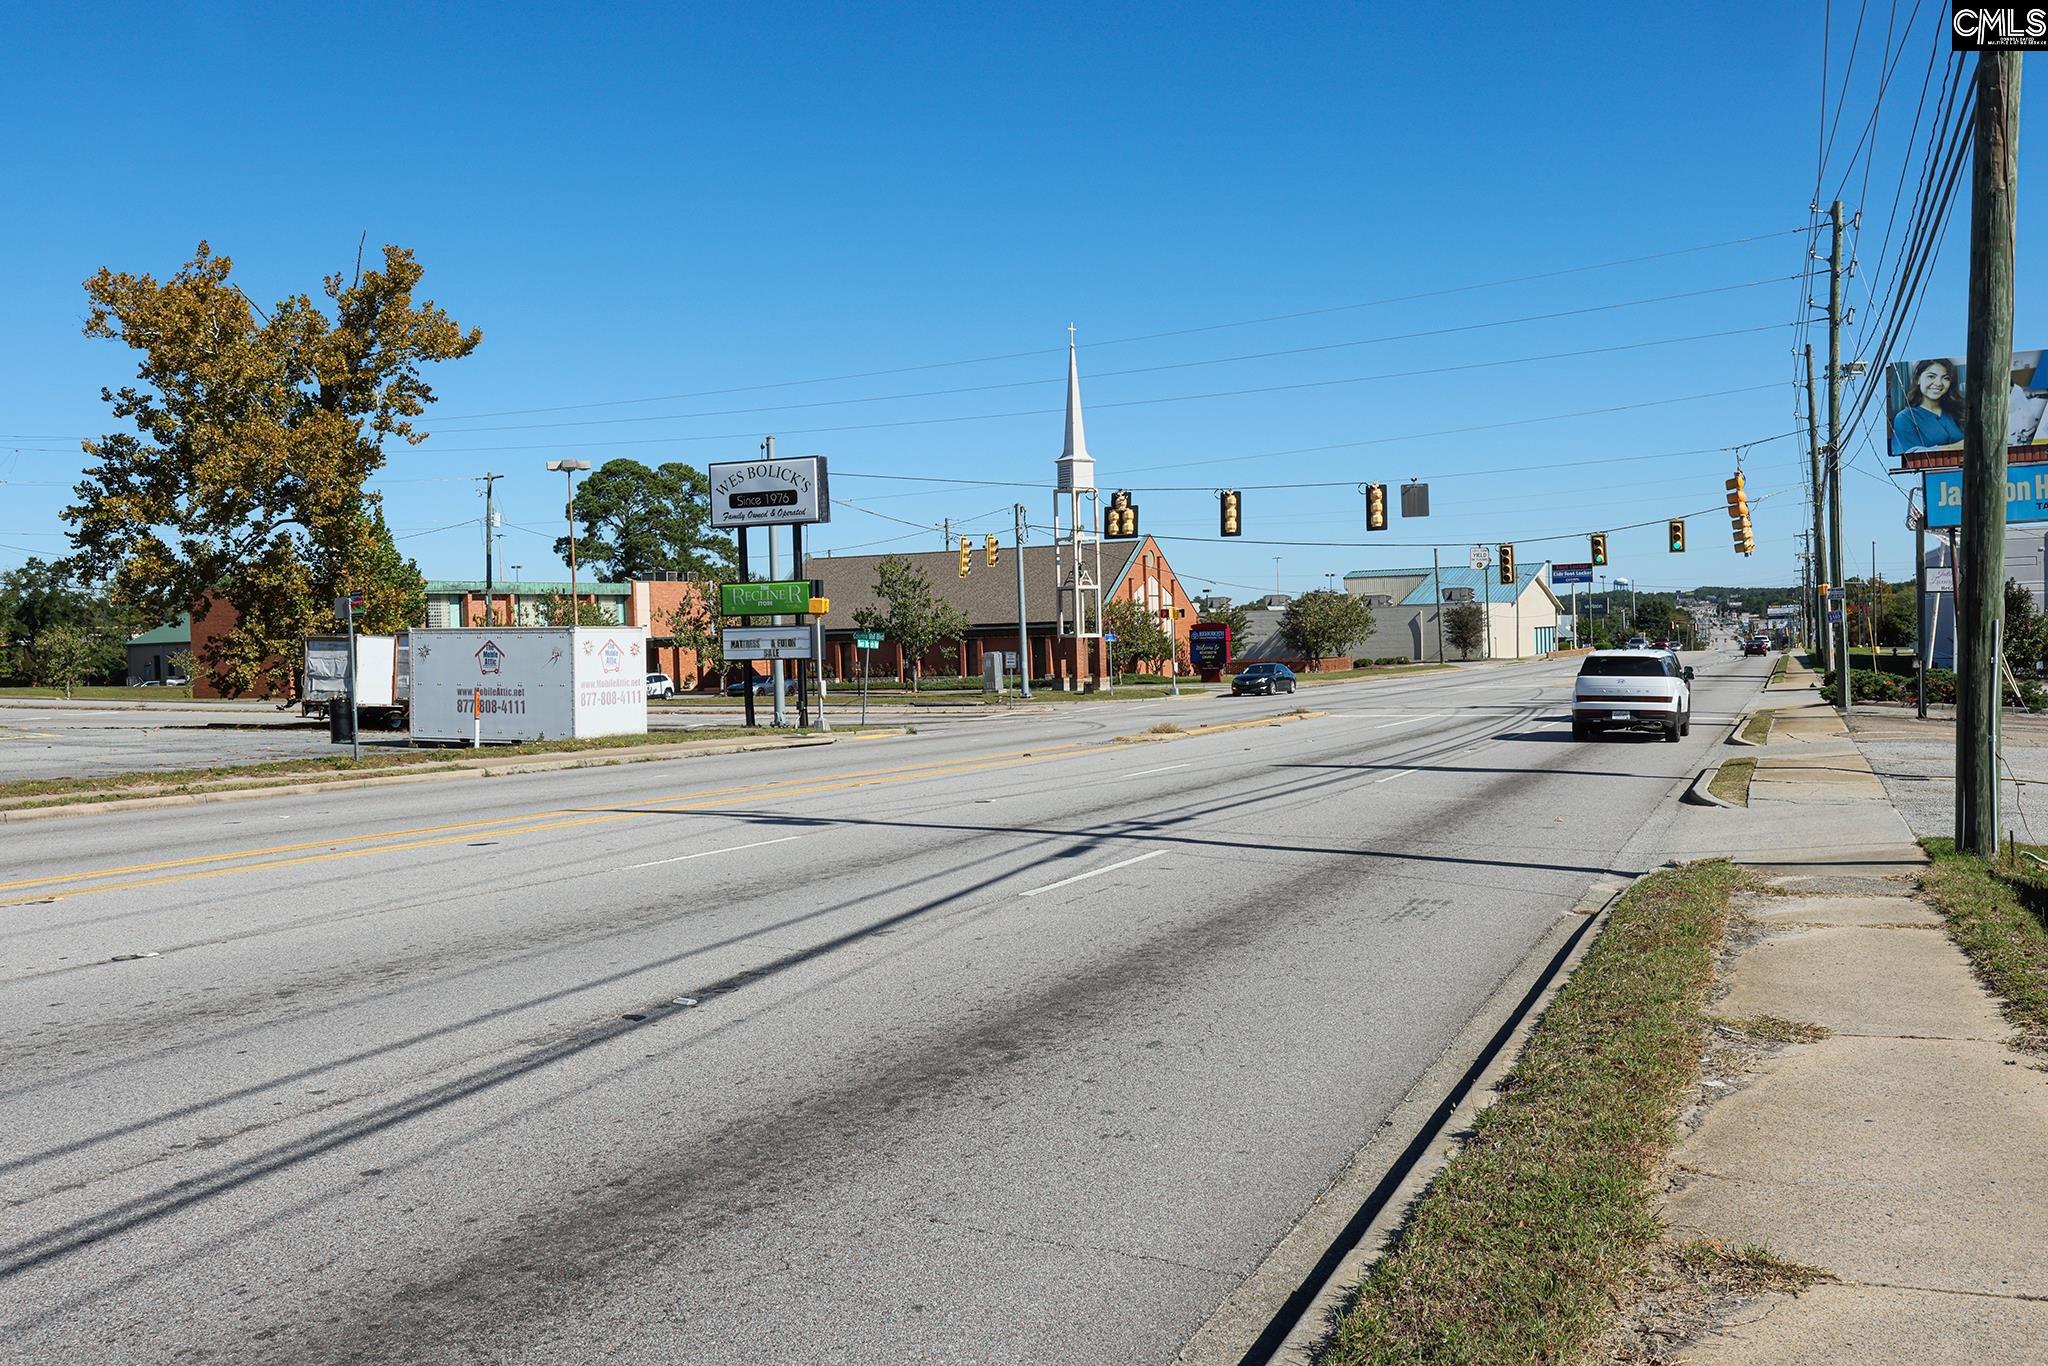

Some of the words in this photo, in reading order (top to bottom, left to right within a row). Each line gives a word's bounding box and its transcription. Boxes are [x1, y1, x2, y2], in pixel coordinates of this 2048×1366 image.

[716, 471, 745, 496] WES
[746, 464, 812, 493] BOLICK'S
[736, 495, 762, 506] Since
[764, 492, 790, 504] 1976
[1938, 480, 2031, 507] Jaon
[722, 511, 746, 521] Family
[747, 510, 768, 519] Owned
[770, 508, 776, 517] &
[777, 508, 807, 517] Operated
[730, 639, 760, 648] MATTRESS
[777, 637, 797, 648] FUTON
[763, 648, 780, 657] SALE
[580, 690, 641, 707] 877-808-4111
[456, 699, 526, 714] 877808-4111
